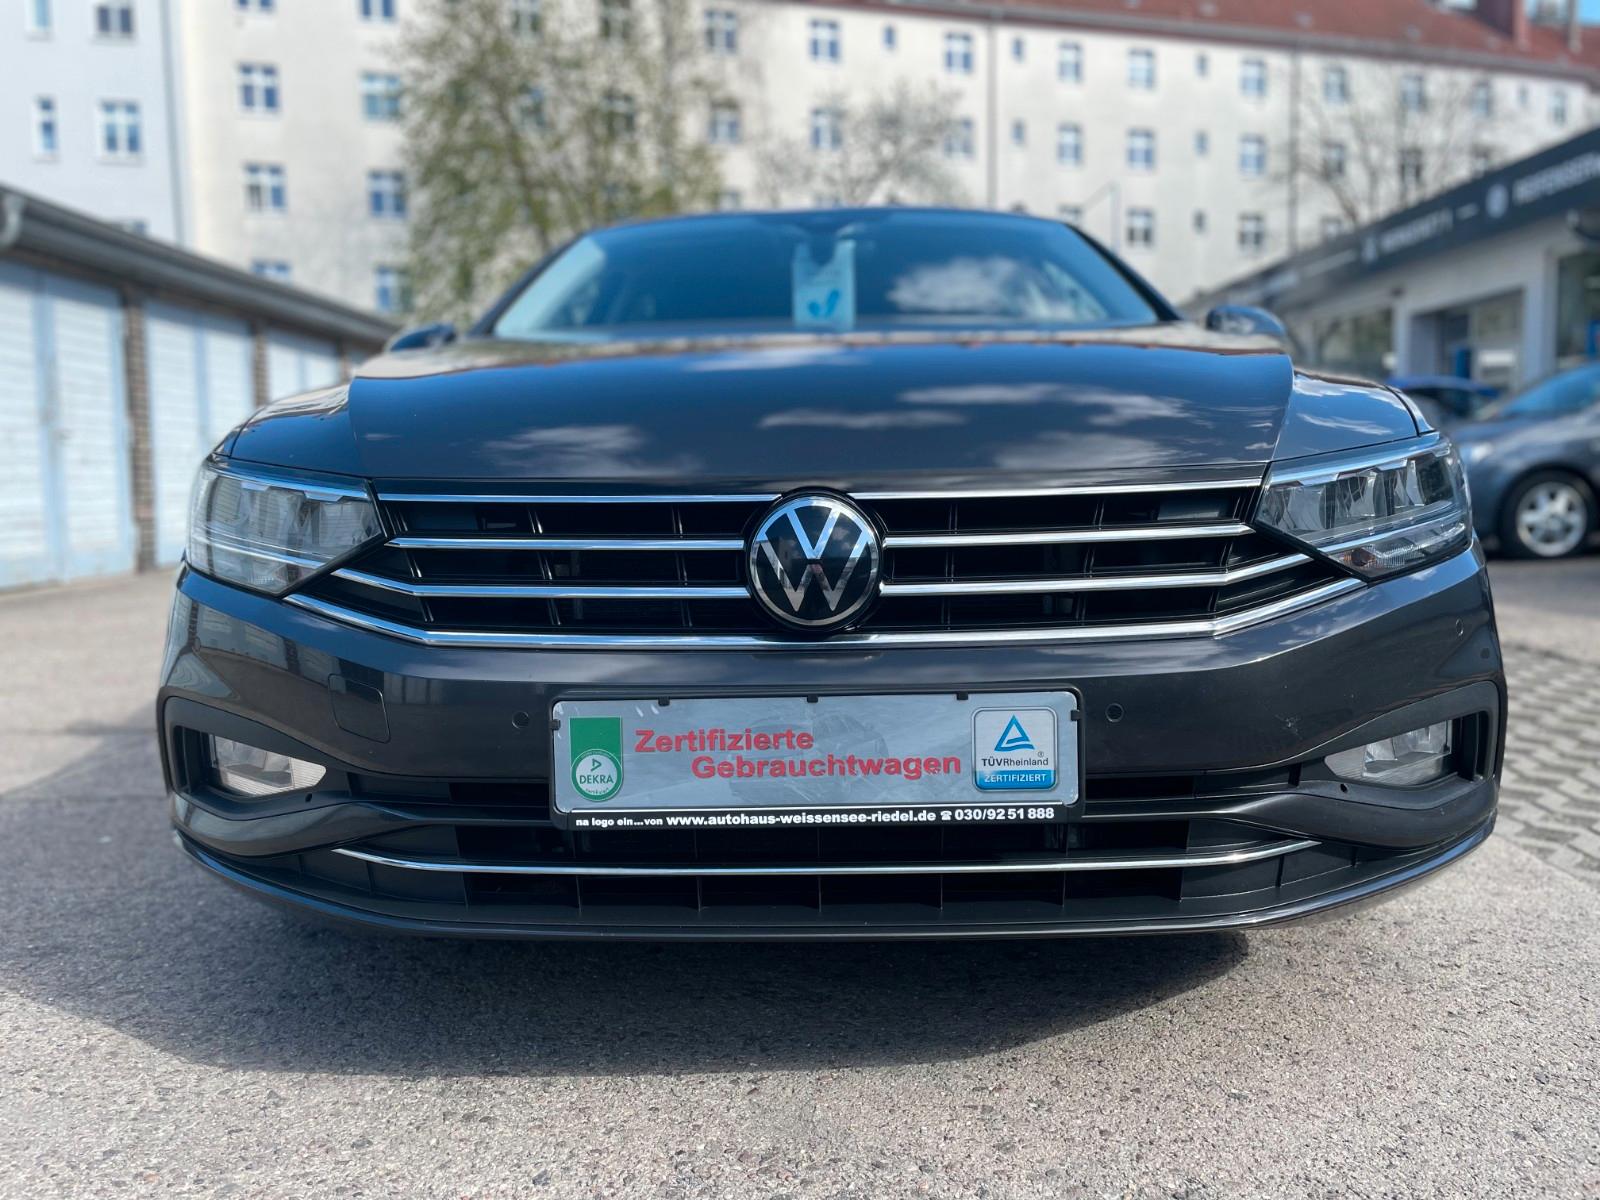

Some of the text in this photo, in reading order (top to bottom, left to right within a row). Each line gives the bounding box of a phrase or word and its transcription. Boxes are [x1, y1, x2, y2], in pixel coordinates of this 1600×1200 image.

[635, 728, 814, 752] Zertifizierte
[692, 754, 961, 780] Gebrauchtwagen
[579, 774, 614, 784] DEKRA
[984, 773, 1047, 783] ZERTIFIZIERT
[591, 817, 615, 828] logo
[666, 810, 937, 826] www.autohaus-weissensee-riedel.de
